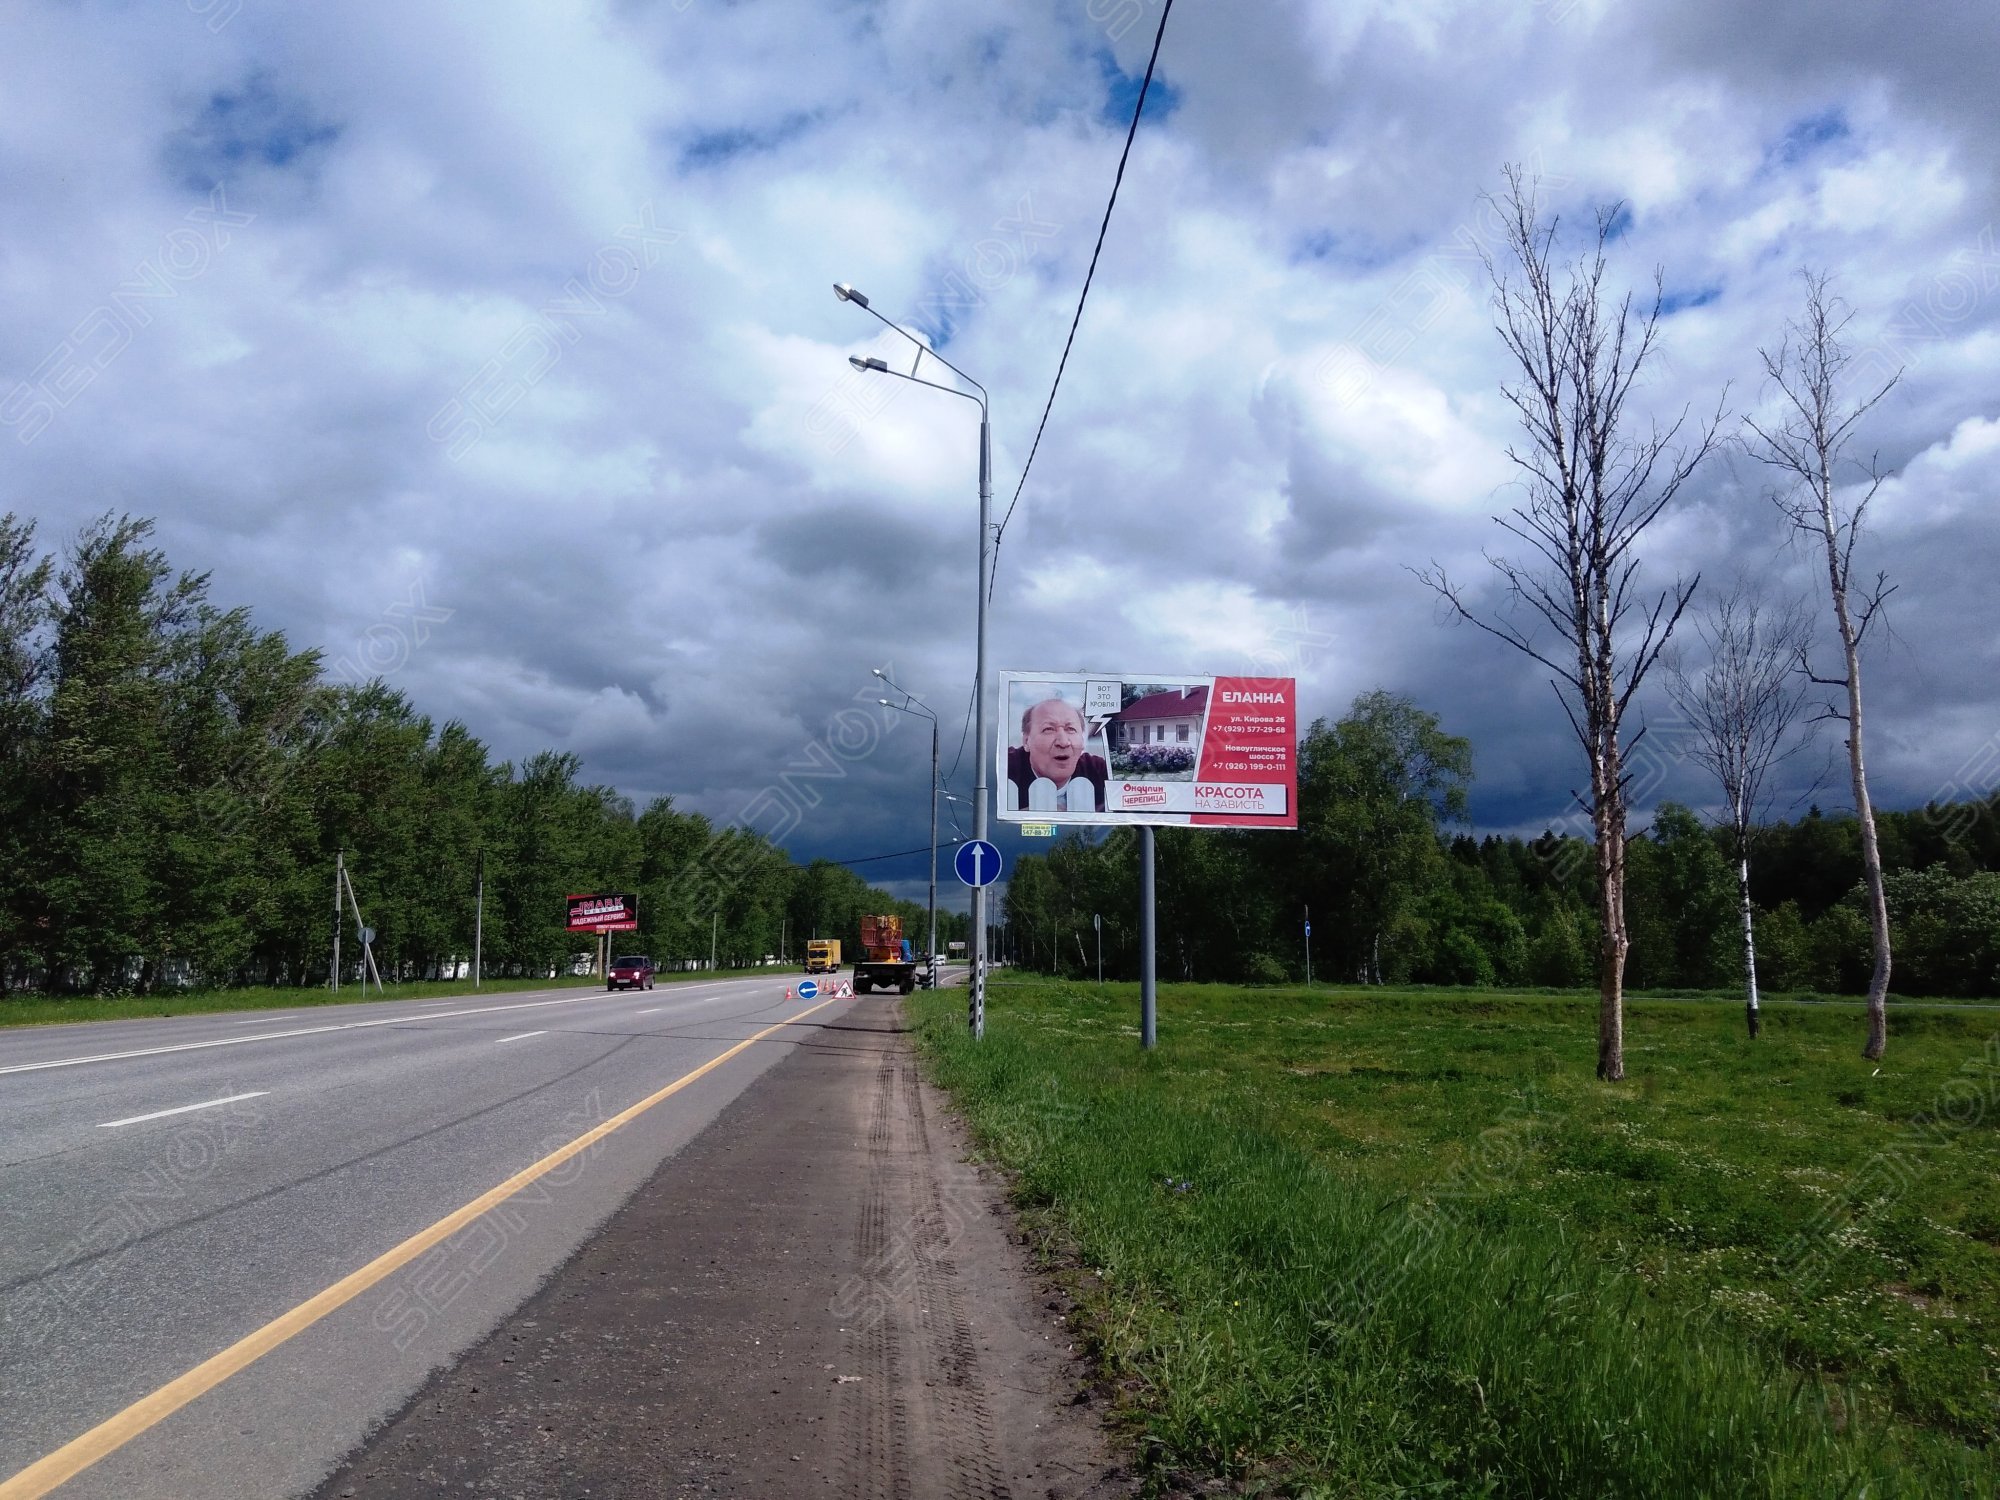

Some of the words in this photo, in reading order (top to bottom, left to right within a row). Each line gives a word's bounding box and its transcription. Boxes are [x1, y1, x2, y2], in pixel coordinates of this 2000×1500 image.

[1222, 691, 1285, 704] ЕЛАННА
[1244, 715, 1274, 724] Кирова
[1225, 744, 1286, 753] Новоугличское
[1225, 762, 1248, 771] (926)
[1194, 786, 1264, 799] КРАСОТА
[1124, 795, 1164, 804] ЧЕРЕПИЦА
[1194, 799, 1213, 809] НА
[1215, 799, 1264, 810] ЗАВИСТЬ
